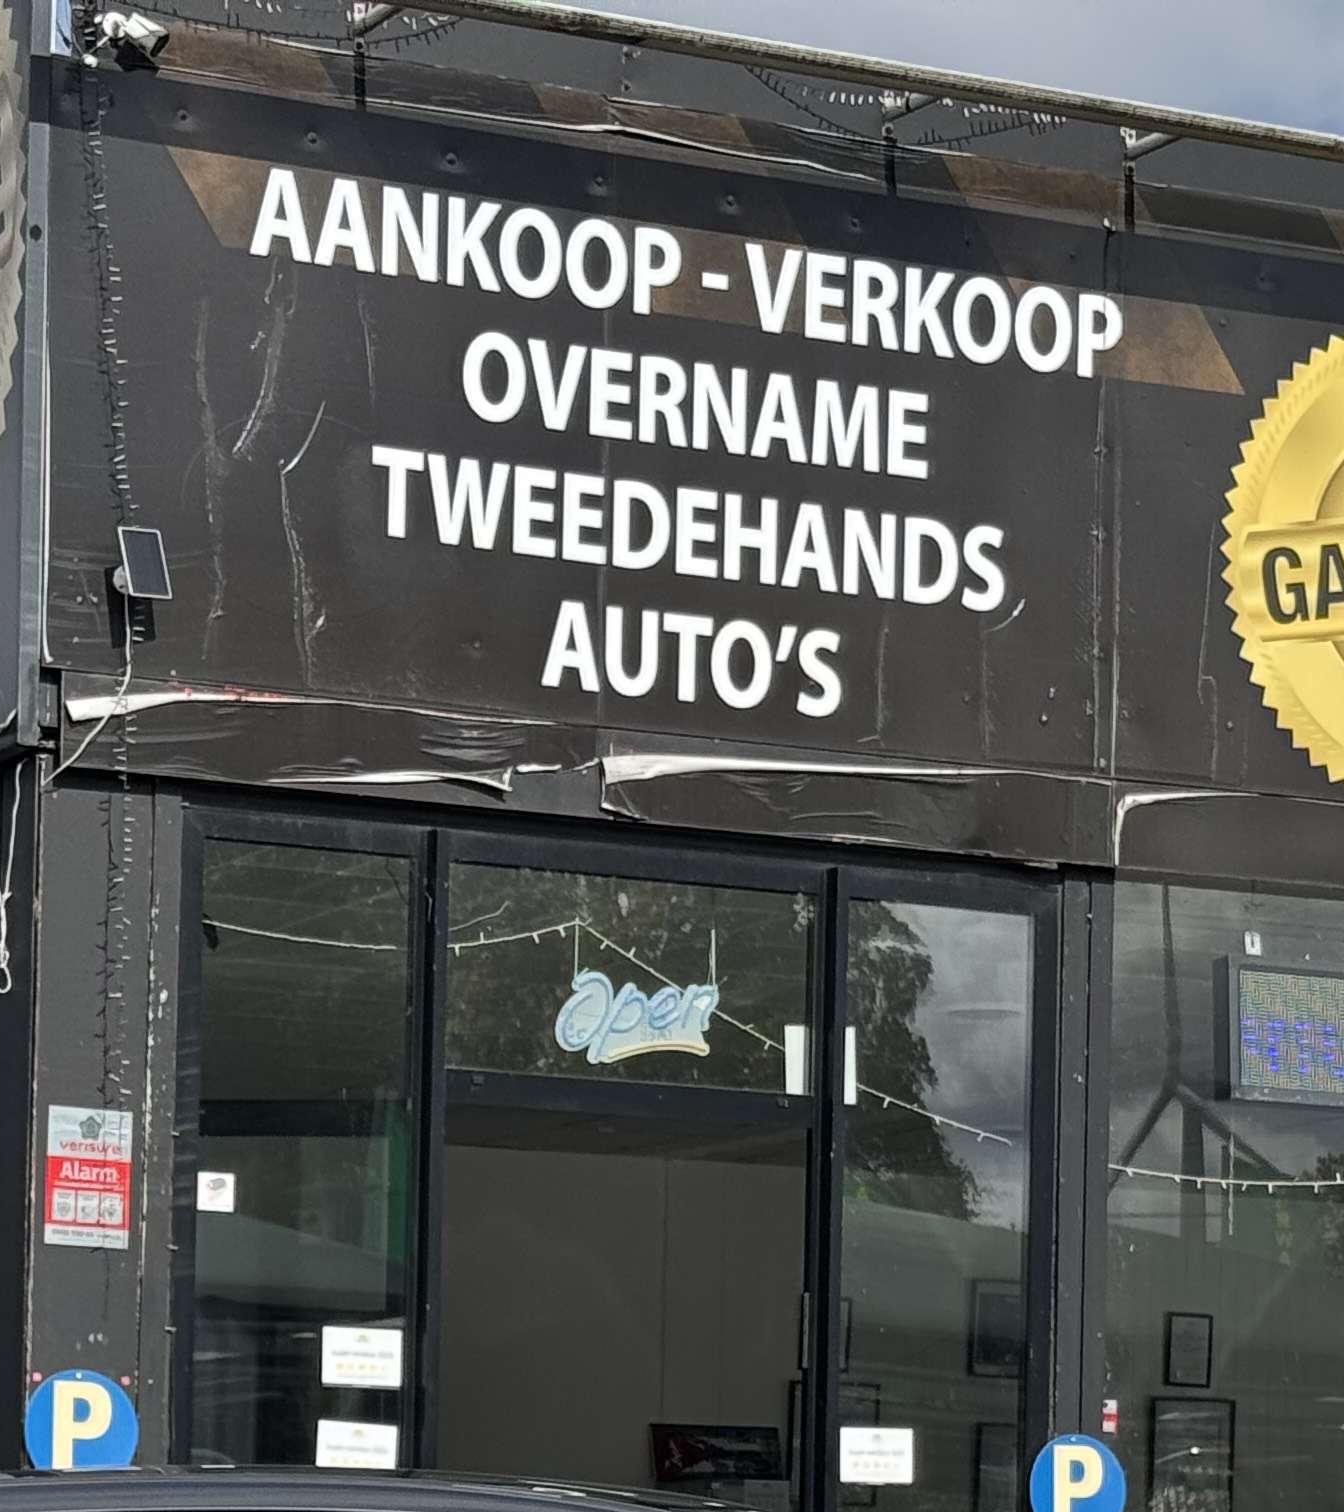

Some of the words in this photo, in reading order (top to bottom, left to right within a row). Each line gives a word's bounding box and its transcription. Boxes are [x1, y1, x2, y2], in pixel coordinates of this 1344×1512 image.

[250, 167, 680, 315] AANKOOP
[702, 270, 730, 291] -
[746, 242, 1124, 379] VERKOOP
[461, 331, 930, 481] OVERNAME
[371, 446, 1005, 613] TWEEDEHANDS
[540, 601, 842, 719] AUTO'S
[555, 971, 719, 1064] Open
[60, 1160, 119, 1183] Alarm
[51, 1380, 113, 1468] P
